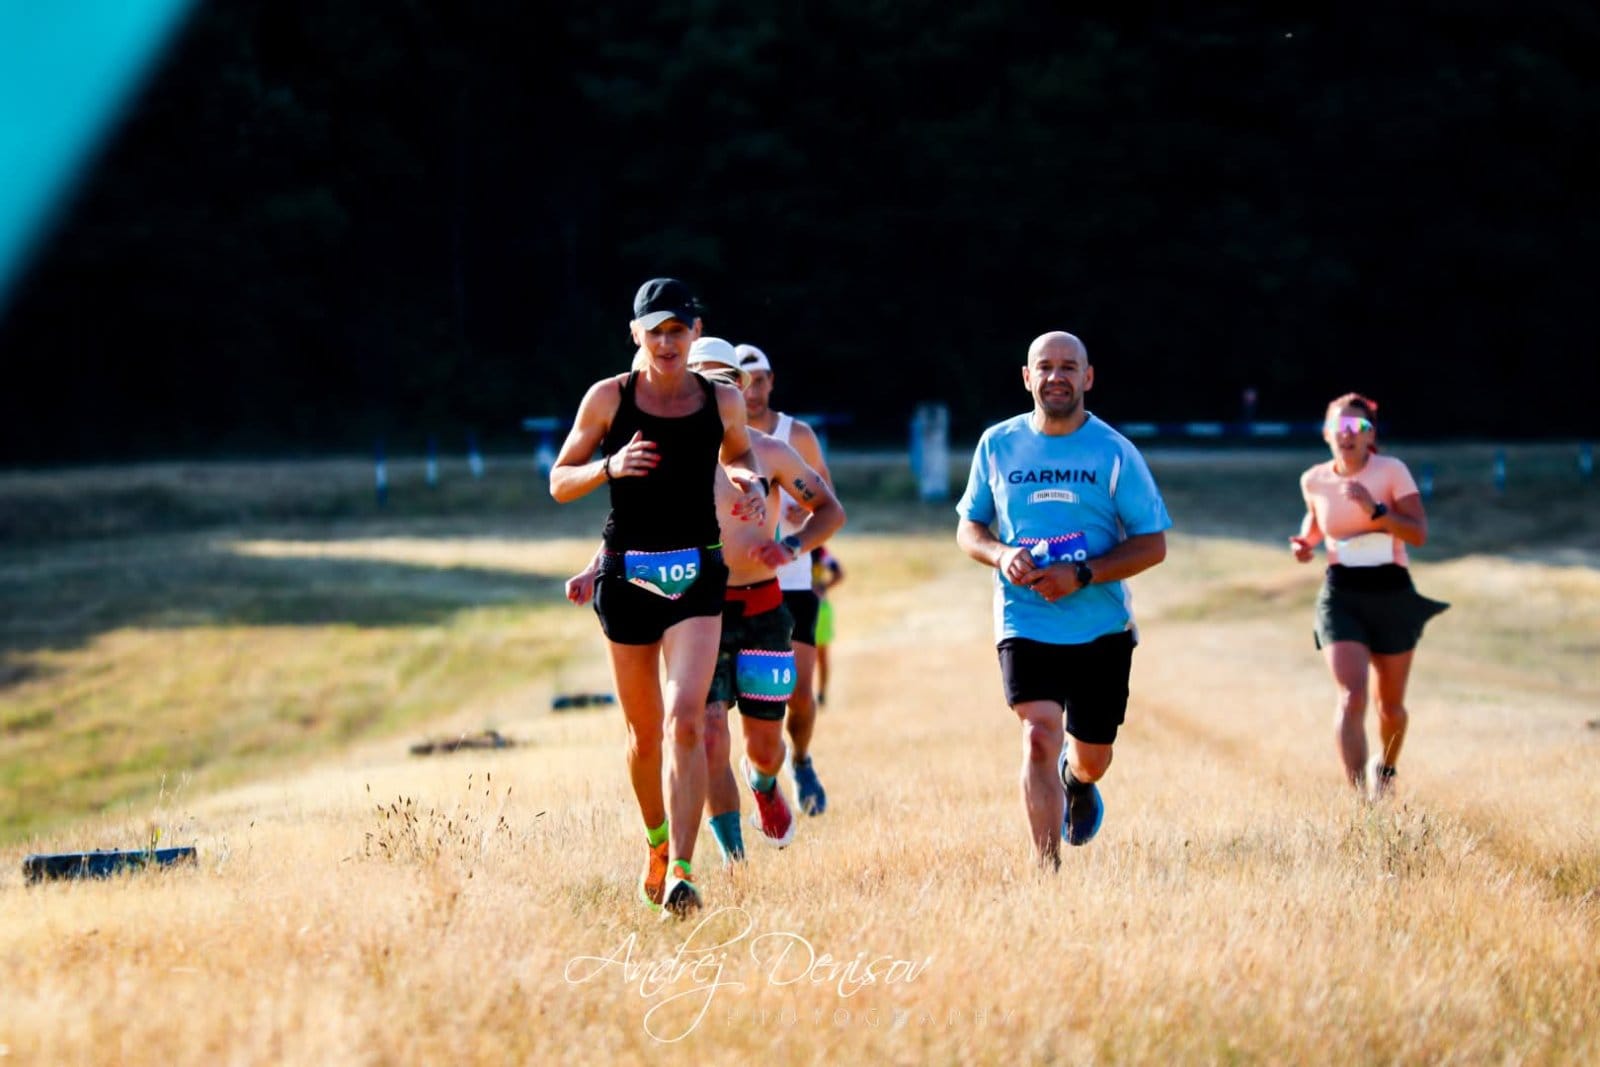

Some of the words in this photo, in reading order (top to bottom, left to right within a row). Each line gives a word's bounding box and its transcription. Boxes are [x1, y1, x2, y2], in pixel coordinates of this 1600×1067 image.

[1008, 470, 1097, 485] GARMIN
[658, 562, 697, 583] 105
[772, 668, 791, 684] 18
